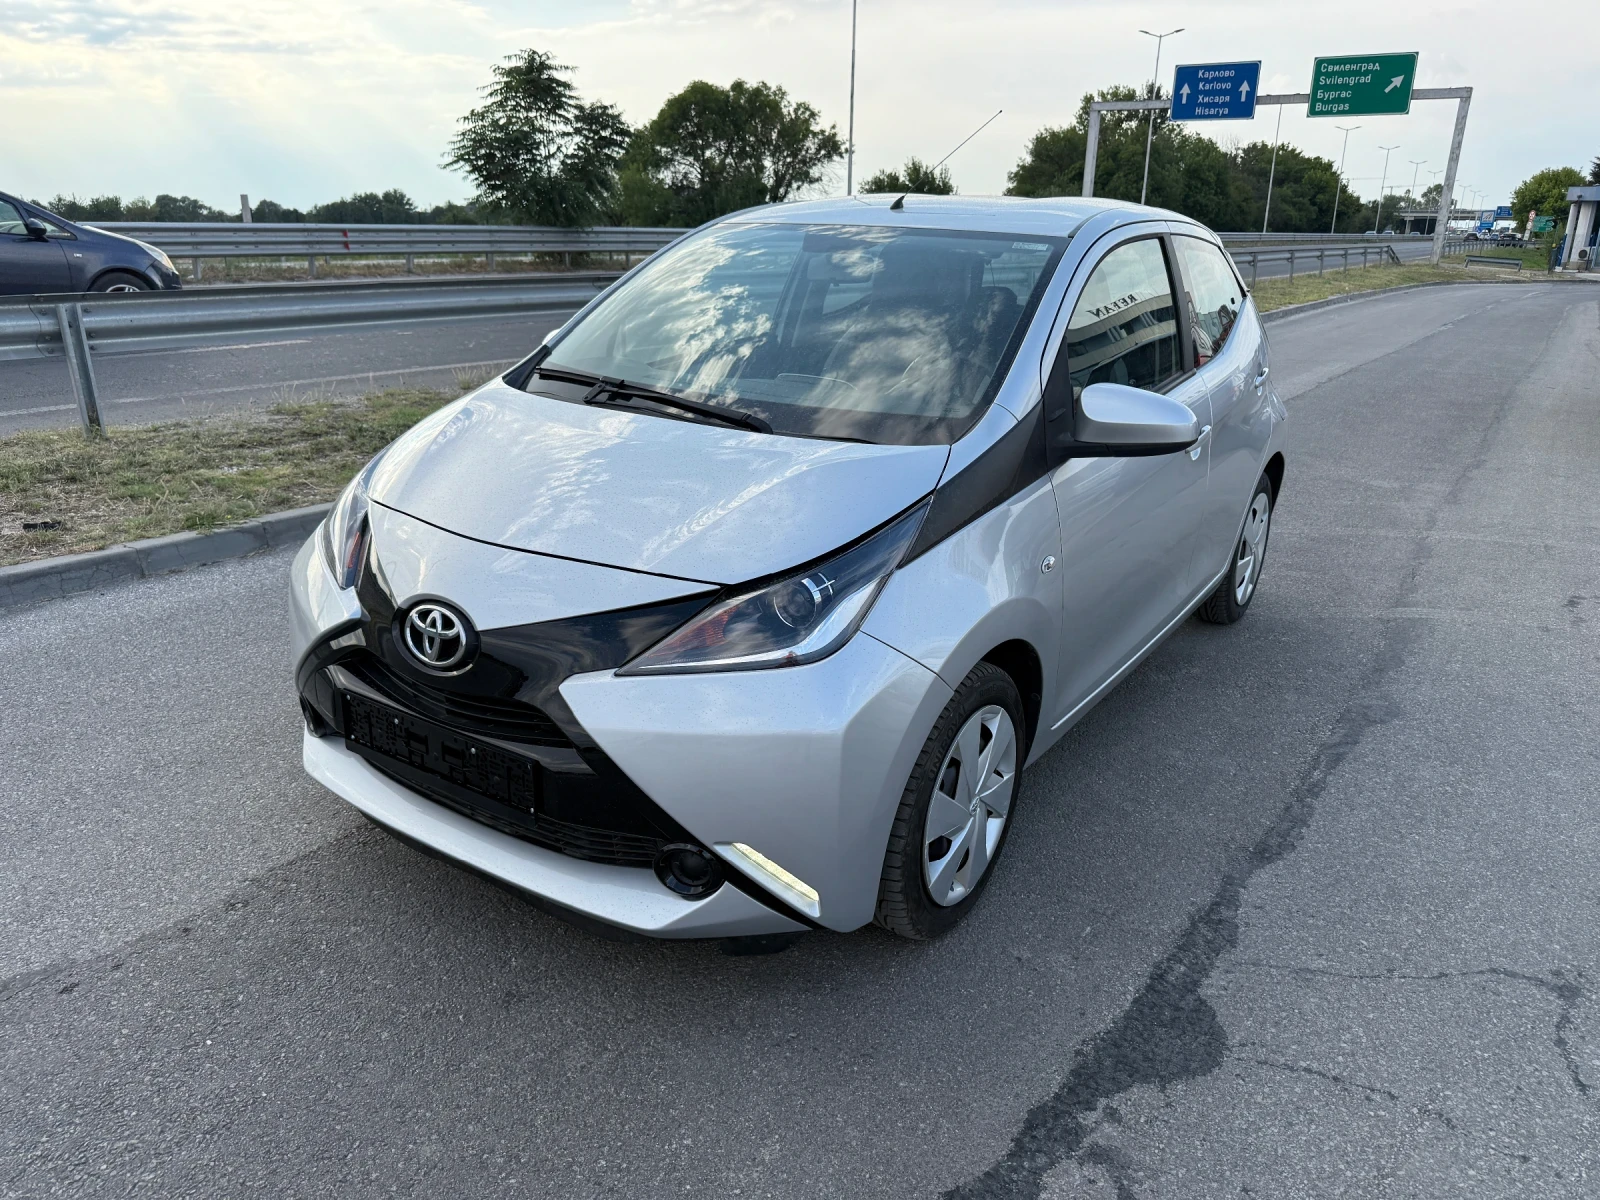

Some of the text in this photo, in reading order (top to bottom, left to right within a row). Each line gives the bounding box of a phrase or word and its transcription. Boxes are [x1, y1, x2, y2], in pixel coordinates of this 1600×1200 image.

[1320, 62, 1381, 73] Свиленград
[1198, 69, 1235, 79] Карлово
[1319, 74, 1372, 86] Svilengrad
[1198, 81, 1232, 91] Karlovo
[1197, 94, 1230, 104] Хисаря
[1317, 89, 1352, 100] Бургас
[1195, 106, 1229, 116] Hisarya
[1315, 102, 1350, 113] Burgas
